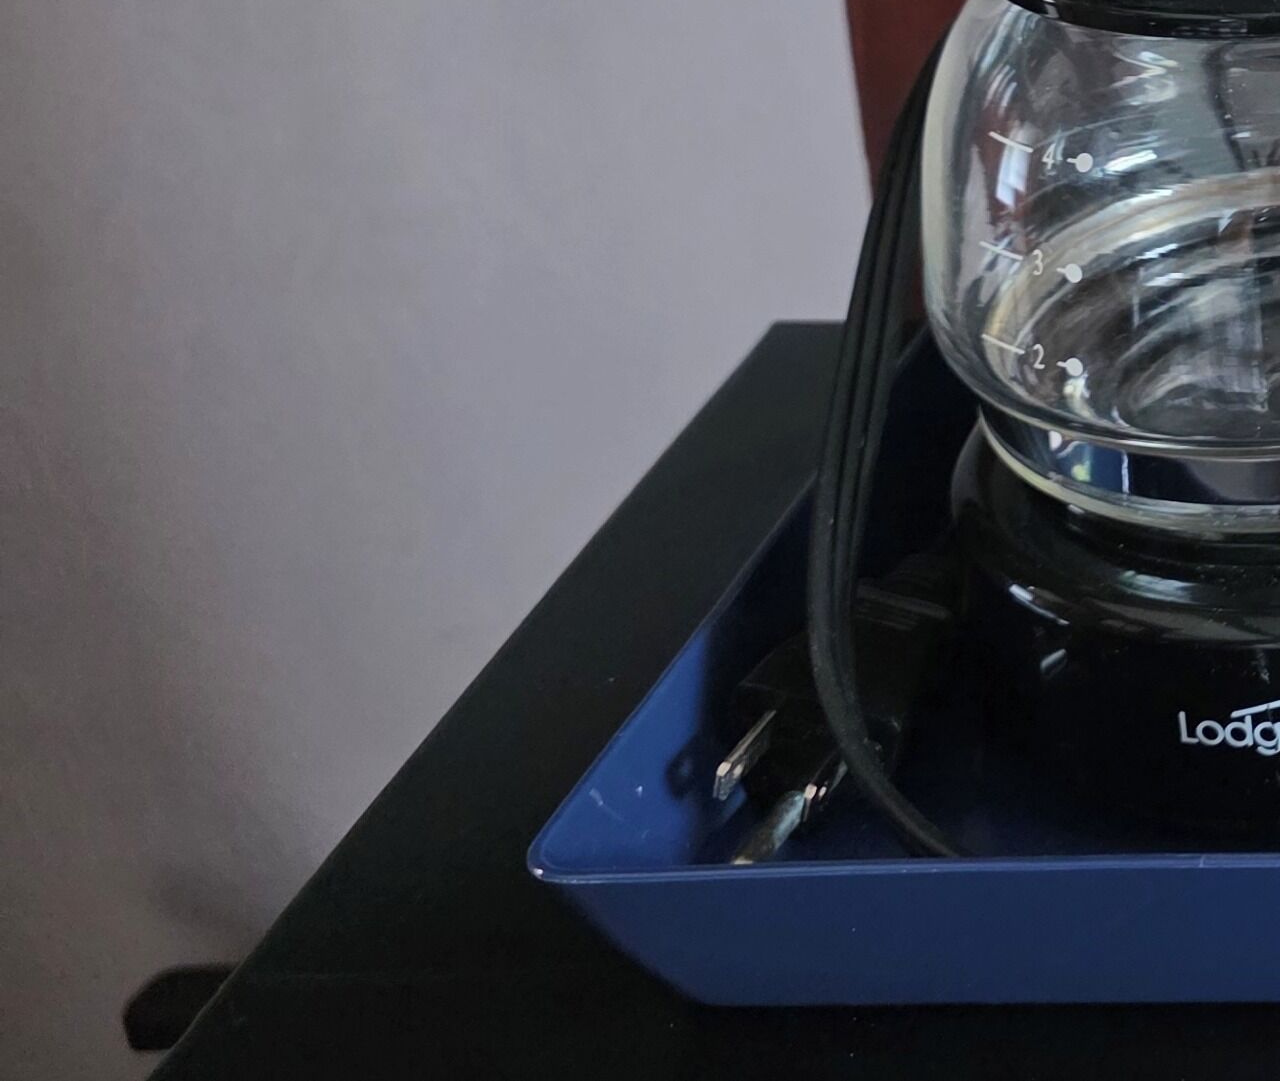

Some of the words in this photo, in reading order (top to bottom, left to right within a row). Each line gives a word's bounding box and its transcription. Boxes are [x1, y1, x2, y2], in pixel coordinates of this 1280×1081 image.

[1041, 143, 1057, 170] 4
[1032, 249, 1044, 276] 3
[1032, 343, 1046, 370] 2
